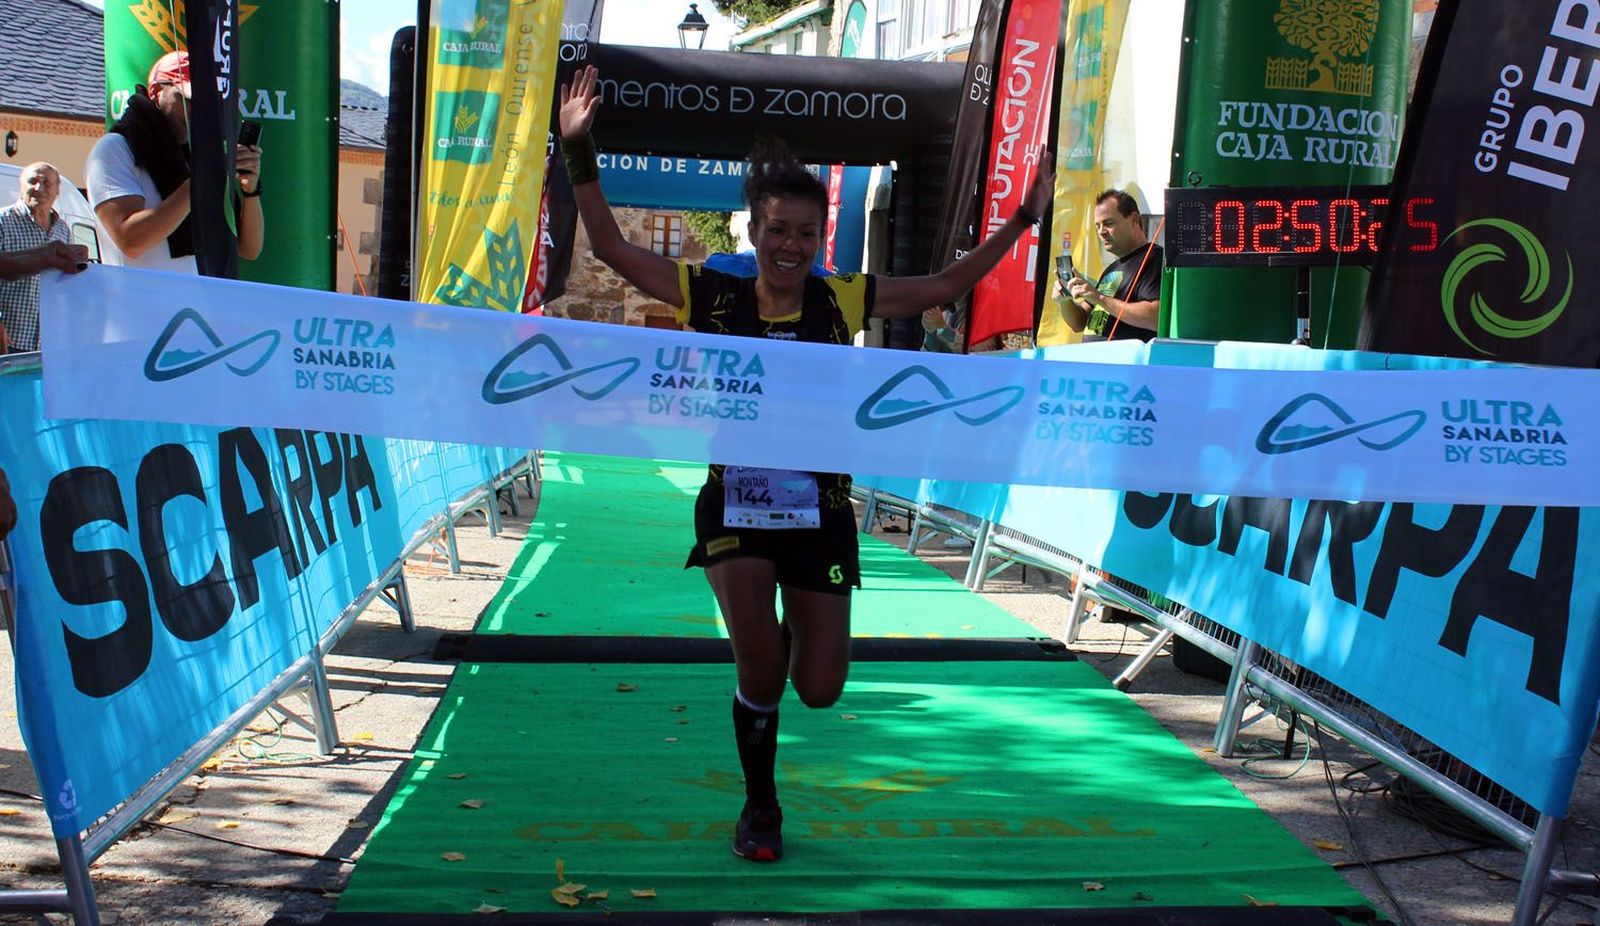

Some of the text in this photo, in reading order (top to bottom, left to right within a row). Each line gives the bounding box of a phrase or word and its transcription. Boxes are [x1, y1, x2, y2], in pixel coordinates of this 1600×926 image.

[506, 24, 533, 116] Ourense
[1217, 101, 1399, 142] FUNDACION
[1474, 64, 1523, 173] GRUPO
[497, 132, 521, 187] León
[1216, 132, 1394, 170] CAJA RURAL
[660, 158, 687, 174] DE
[293, 316, 396, 349] ULTRA
[293, 348, 396, 370] SANABRIA
[655, 344, 766, 378] ULTRA
[295, 370, 395, 395] BY STAGES
[650, 372, 764, 395] SANABRIA
[1039, 377, 1158, 405] ULTRA
[648, 393, 760, 422] BY STAGES
[1037, 402, 1158, 424] SANABRIA
[1441, 398, 1565, 427] ULTRA
[1035, 421, 1155, 447] BY STAGES
[1442, 425, 1569, 446] SANABRIA
[1444, 444, 1569, 467] BY STAGES
[737, 474, 770, 489] MONTAÑO
[734, 486, 774, 508] 144
[40, 427, 383, 699] SCARPA
[802, 817, 1158, 843] RURAL
